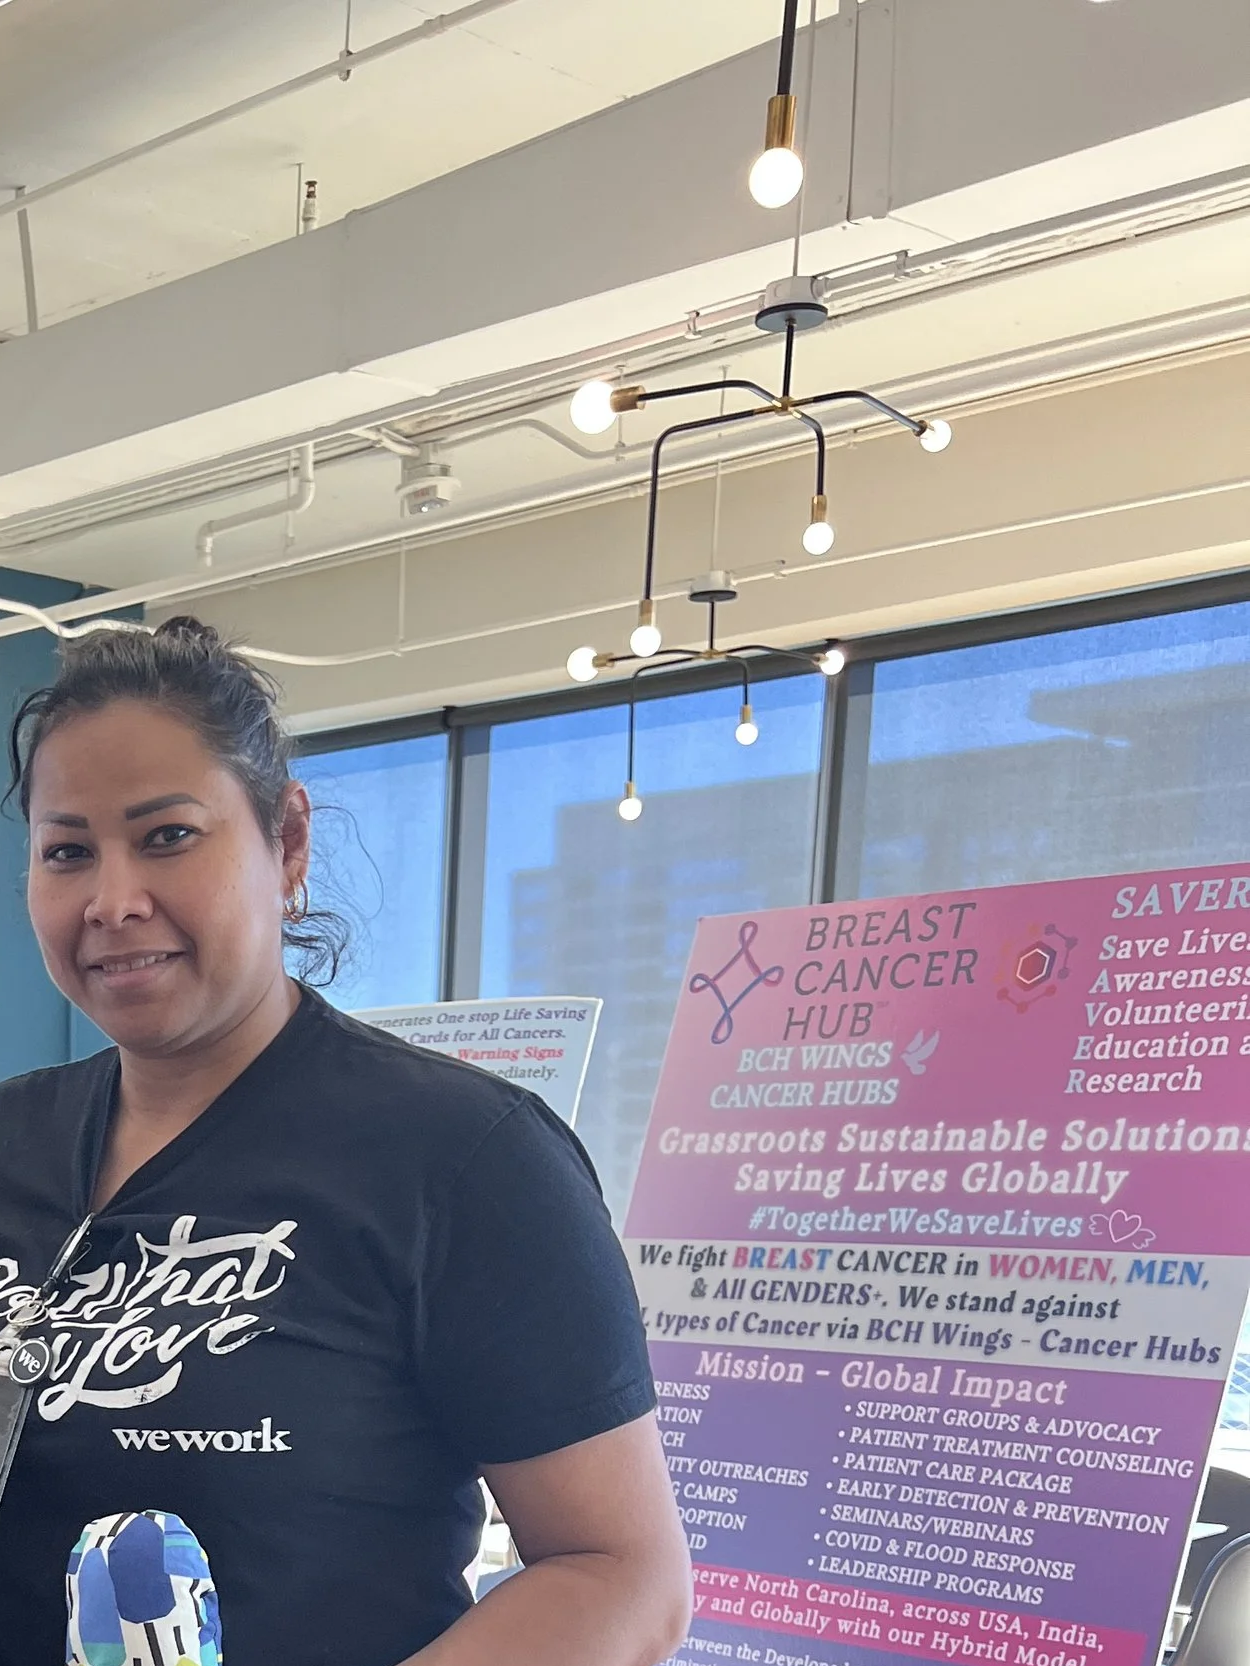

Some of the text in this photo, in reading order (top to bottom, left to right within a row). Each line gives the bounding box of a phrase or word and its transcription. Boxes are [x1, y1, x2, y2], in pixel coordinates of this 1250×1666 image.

[805, 902, 977, 951] BREAST
[1098, 927, 1250, 961] Save Live
[794, 948, 979, 996] CANCER
[437, 1007, 588, 1025] One stop Life Saving
[783, 1002, 874, 1041] HUB
[1084, 993, 1250, 1028] Volunteeri
[409, 1030, 450, 1045] Cards
[453, 1029, 476, 1043] for
[478, 1027, 500, 1041] All
[503, 1026, 566, 1040] Cancers.
[523, 1046, 564, 1061] Signs
[1072, 1031, 1229, 1061] Education
[736, 1040, 893, 1073] BCH WINGS
[709, 1078, 899, 1109] CANCER HUBS
[1063, 1063, 1203, 1094] Research
[659, 1126, 826, 1155] Grassroots
[837, 1118, 1048, 1152] Sustainable
[734, 1160, 1130, 1204] Saving Lives Globally
[748, 1204, 1083, 1238] #TogetherWeSaveLives
[640, 1243, 1210, 1290] We fight BREAST CANCER in WOMEN, MEN,
[713, 1278, 747, 1301] All
[898, 1285, 939, 1310] We
[945, 1290, 1017, 1314] stand
[1021, 1294, 1121, 1323] against
[656, 1310, 711, 1337] types
[715, 1310, 739, 1333] of
[742, 1311, 822, 1338] Cancer
[827, 1315, 859, 1340] via
[866, 1318, 926, 1345] BCH
[931, 1321, 1013, 1356] Wings
[1039, 1328, 1138, 1359] Cancer
[1144, 1335, 1223, 1365] Hubs
[695, 1350, 1068, 1408] Mission Global Impact
[112, 1417, 292, 1452] wework
[855, 1400, 1162, 1445] SUPPORT GROUPS ADVOCACY
[699, 1459, 809, 1487] OUTREACHES
[849, 1426, 1195, 1479] PATIENT TREATMENT COUNSELING
[683, 1482, 739, 1504] CAMPS
[842, 1452, 1073, 1495] PATIENT CARE PACKAGE
[830, 1504, 1035, 1547] SEMINARS/WEBINARS
[836, 1478, 1170, 1536] EARLY DETECTION PREVENTION
[824, 1529, 1076, 1582] COVID FLOOD RESPONSE
[818, 1555, 1044, 1606] LEADERSHIP PROGRAMS
[710, 1596, 745, 1615] and
[750, 1600, 831, 1635] Globally
[837, 1617, 881, 1640] with
[887, 1628, 925, 1647] our
[930, 1631, 1009, 1662] Hybrid
[744, 1573, 798, 1599] North
[806, 1583, 895, 1618] Carolina,
[902, 1602, 971, 1627] across
[978, 1610, 1029, 1640] USA,
[1037, 1620, 1104, 1653] India,
[736, 1642, 761, 1662] the
